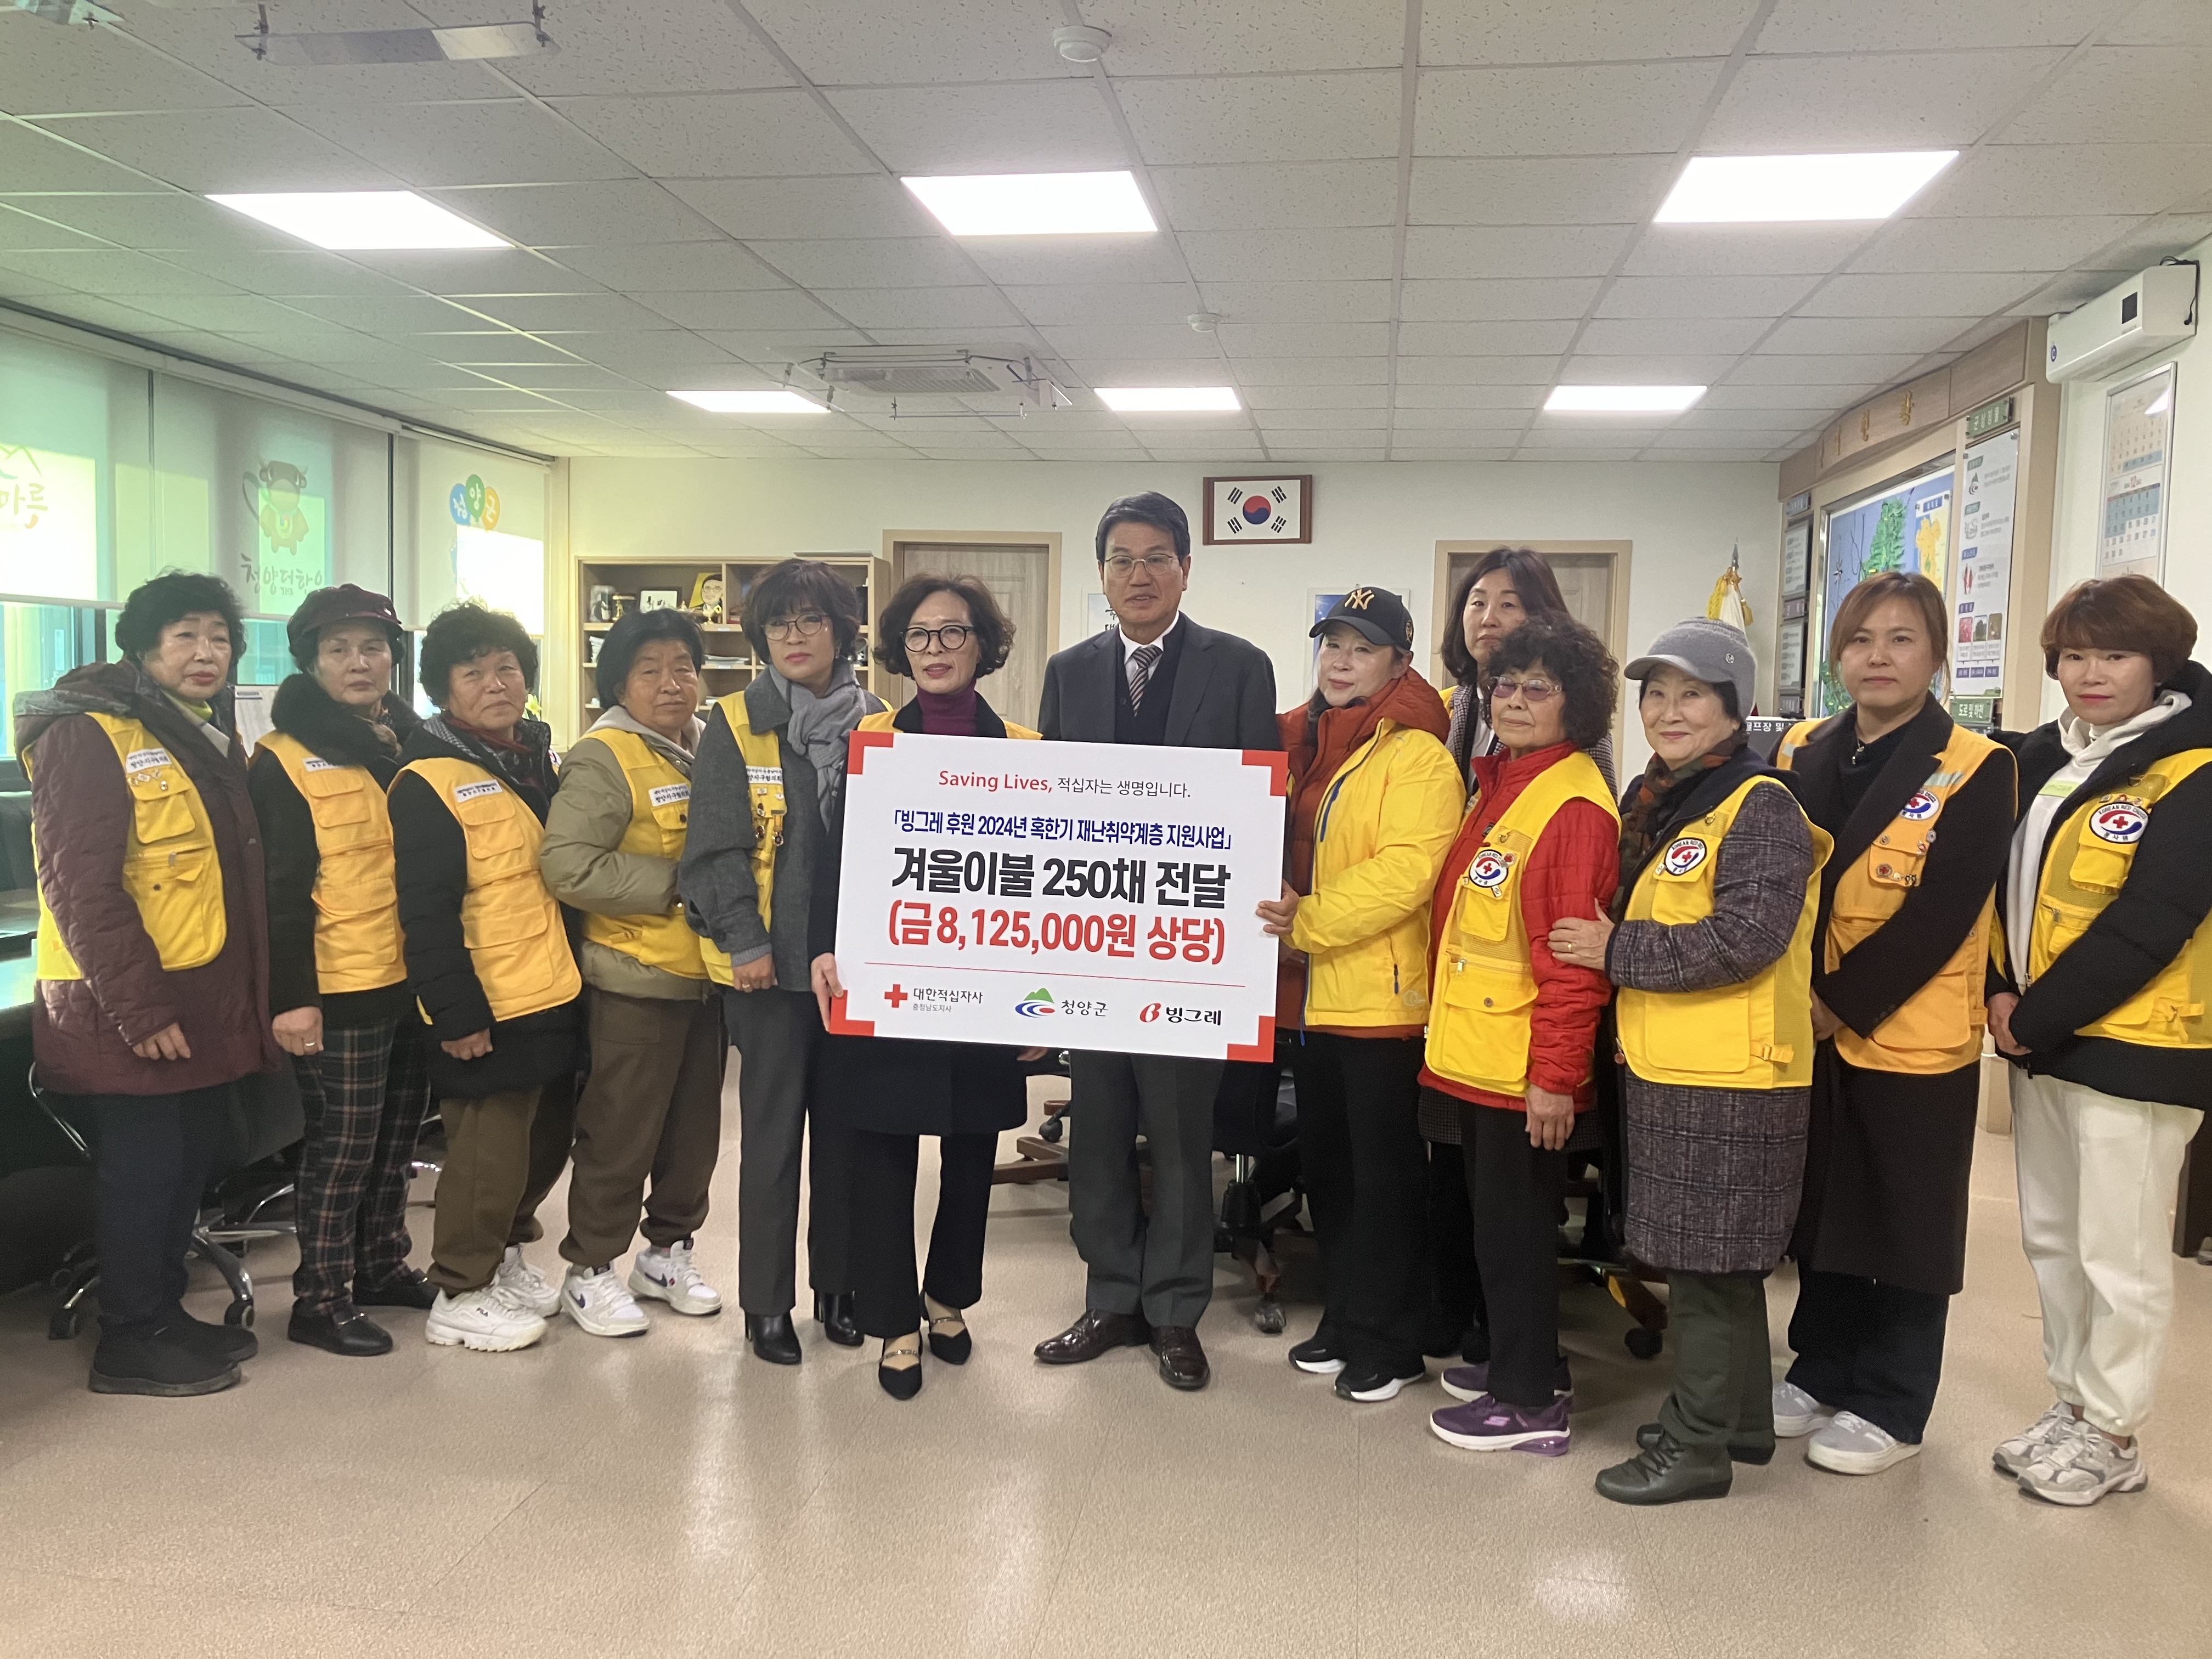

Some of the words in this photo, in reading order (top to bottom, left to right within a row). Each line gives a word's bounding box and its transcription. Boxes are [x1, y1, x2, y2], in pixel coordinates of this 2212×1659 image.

[1344, 589, 1374, 610] NY
[939, 771, 998, 792] Saving
[1005, 774, 1052, 793] Lives,
[1058, 777, 1112, 794] 적십자는
[1117, 781, 1190, 798] 생명입니다.
[946, 812, 974, 836] 후원
[978, 816, 1026, 838] 2024년
[1031, 817, 1073, 840] 혹한기
[1077, 820, 1163, 845] 재난취약계층
[892, 848, 1034, 898] 겨울이불
[1042, 858, 1146, 904] 250채
[1156, 862, 1231, 909] 전달
[1148, 917, 1224, 964] 상당)
[913, 988, 983, 1003] 대한적십자사
[913, 1003, 951, 1012] 충청남도지사
[1062, 1000, 1108, 1017] 청양군
[1166, 1007, 1221, 1025] 빙그레
